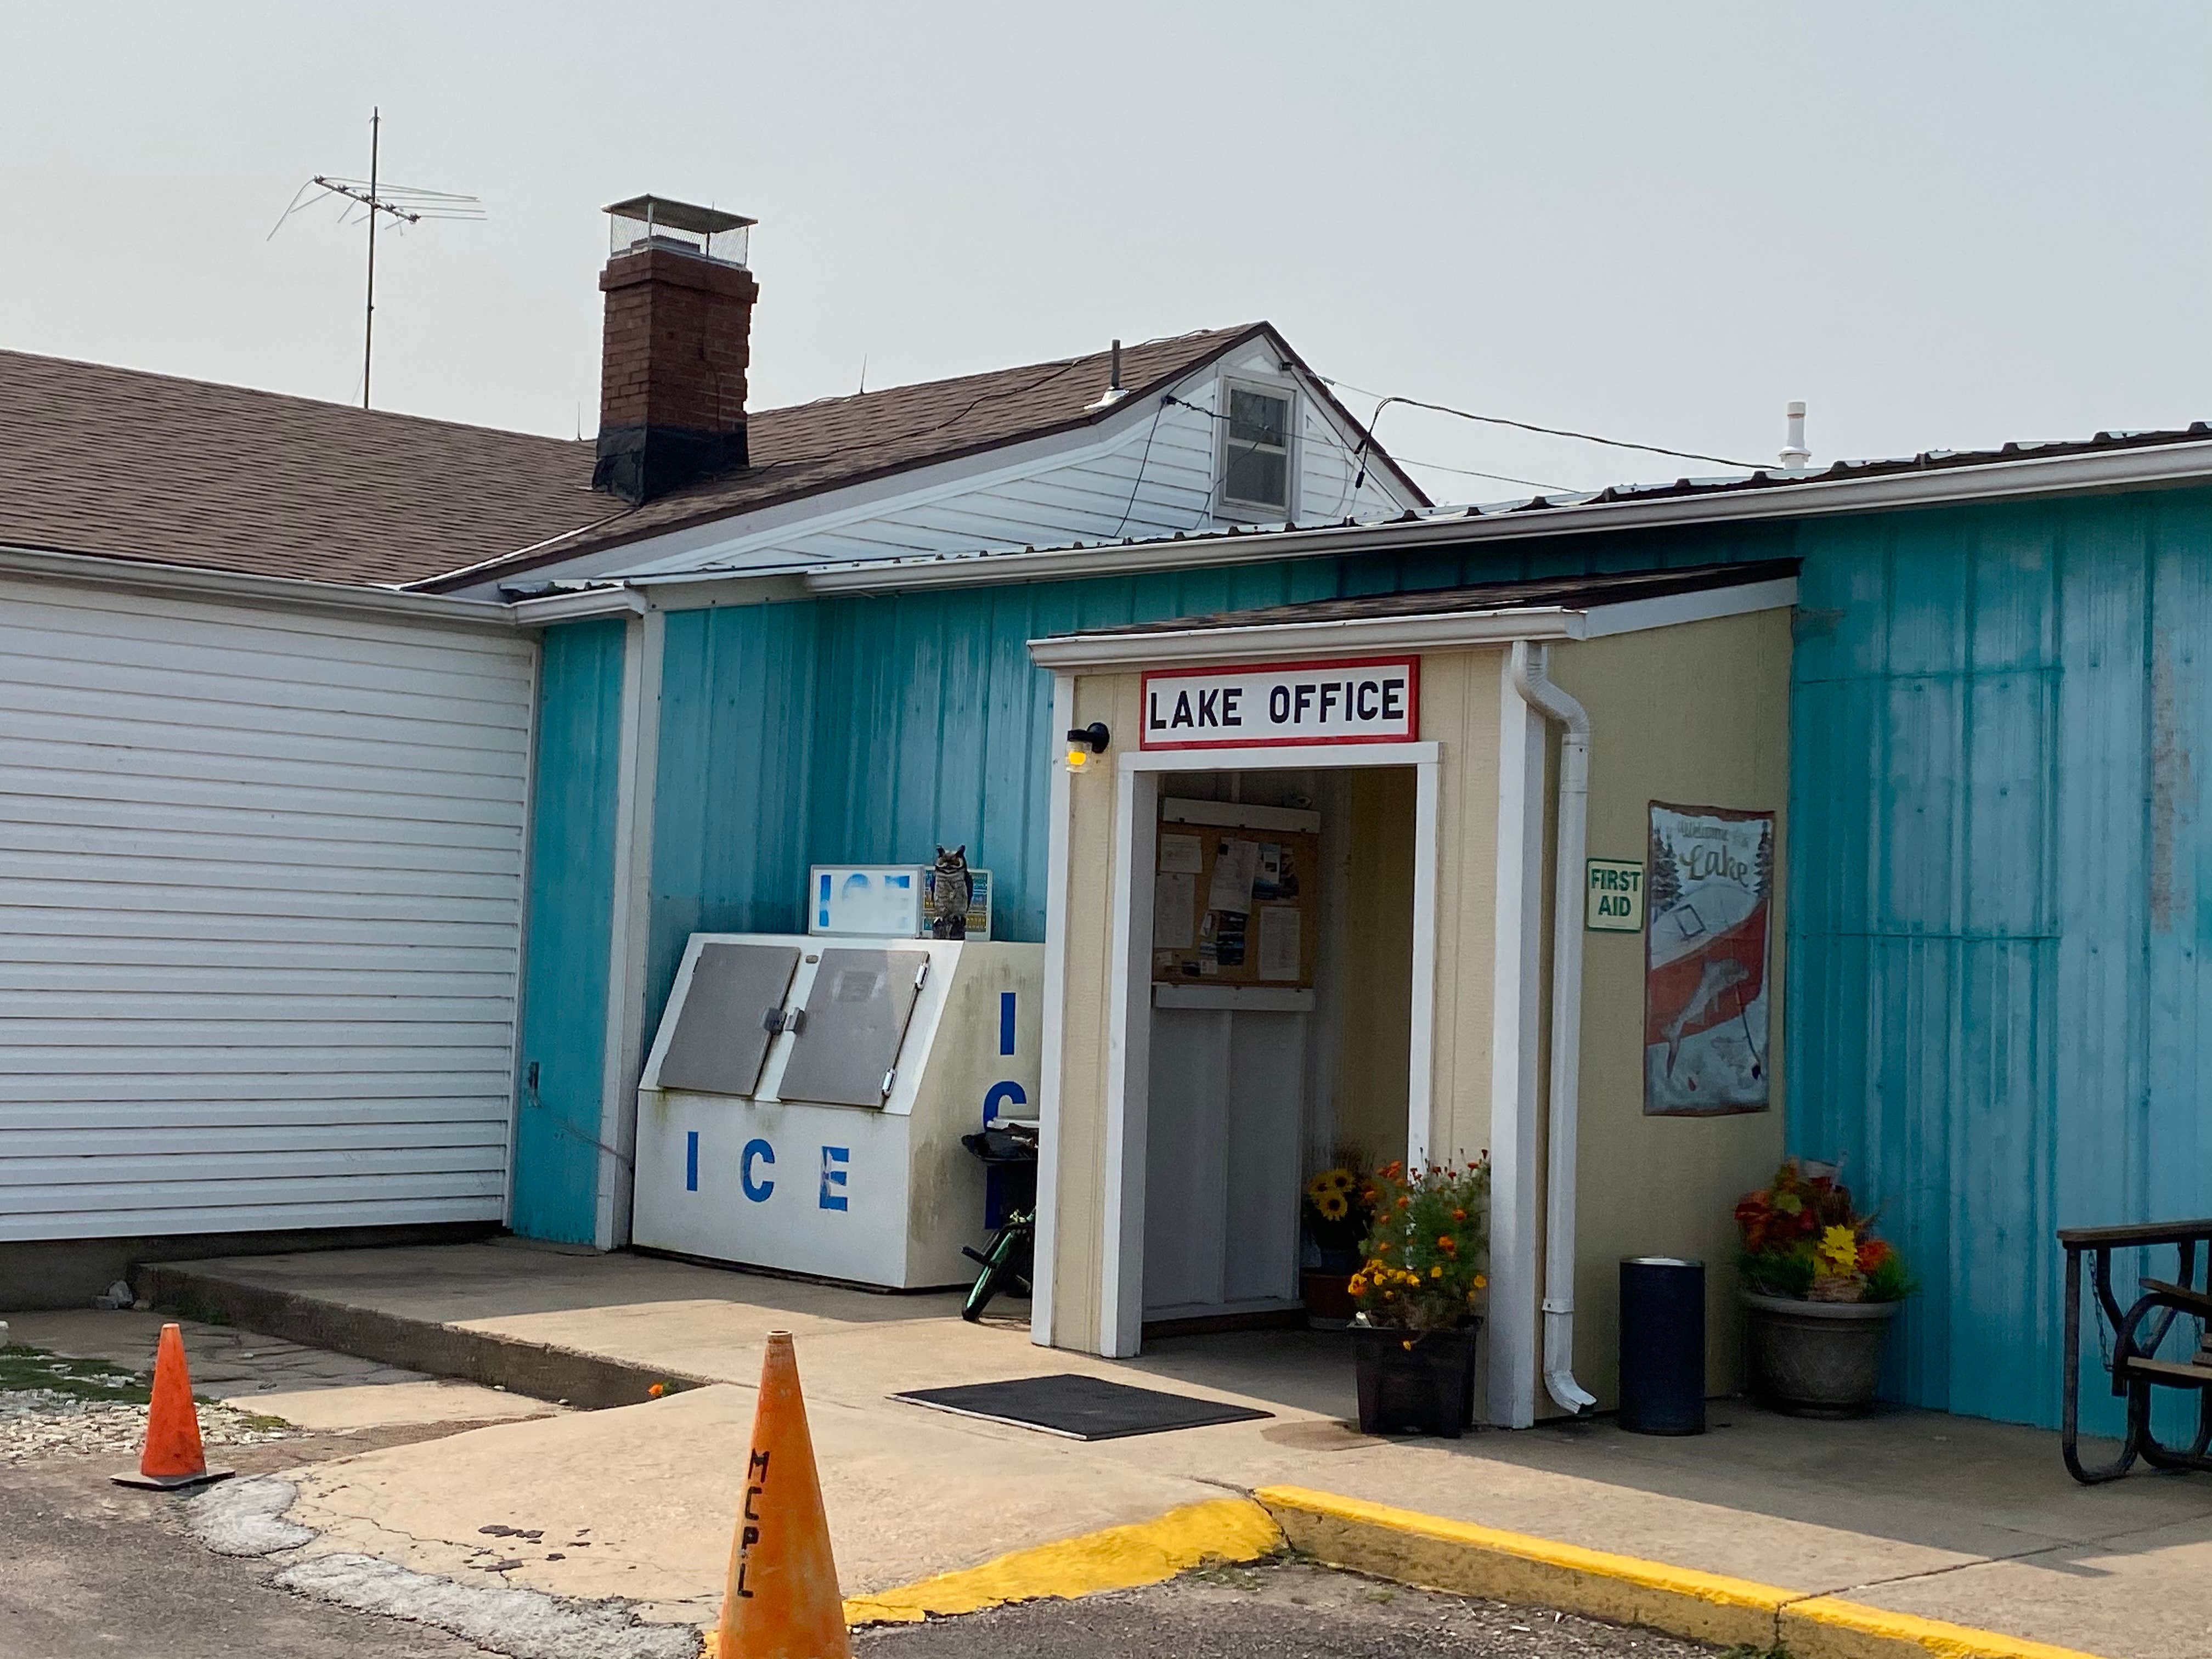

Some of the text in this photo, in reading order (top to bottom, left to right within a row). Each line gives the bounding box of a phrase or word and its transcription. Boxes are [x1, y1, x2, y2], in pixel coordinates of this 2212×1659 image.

[1150, 679, 1404, 730] LAKE OFFICE
[1591, 868, 1641, 891] FIRST
[1679, 844, 1749, 887] Lake
[1598, 895, 1632, 917] AID
[686, 1131, 849, 1211] ICE
[737, 1448, 770, 1599] MCPL
